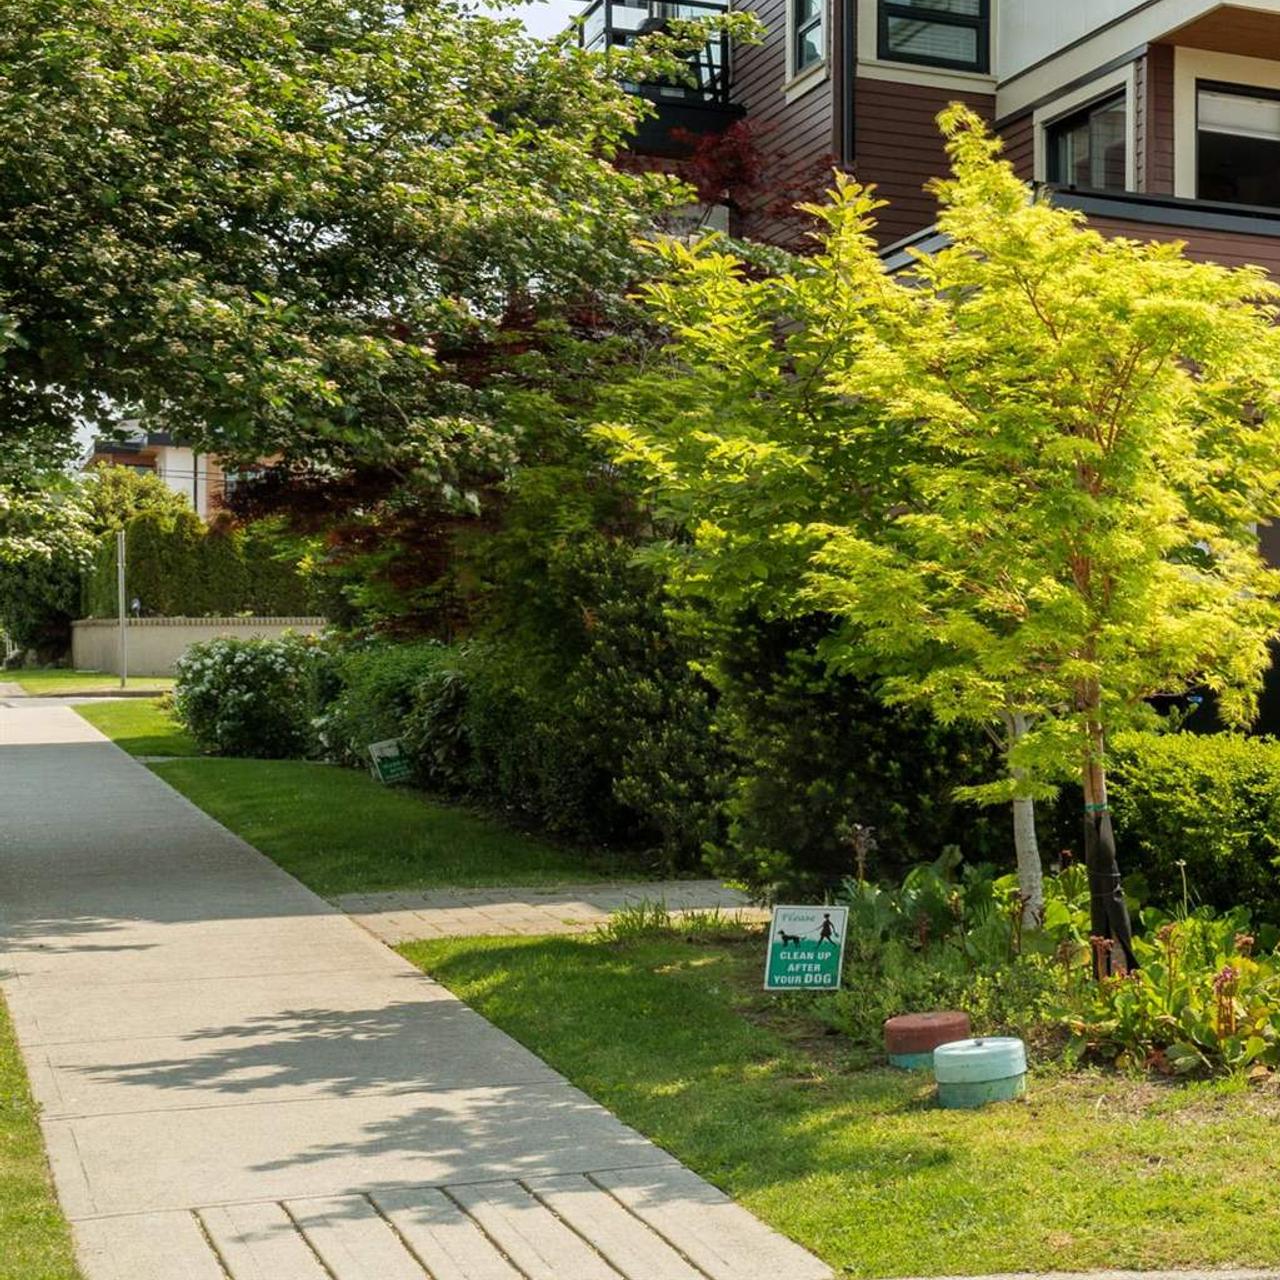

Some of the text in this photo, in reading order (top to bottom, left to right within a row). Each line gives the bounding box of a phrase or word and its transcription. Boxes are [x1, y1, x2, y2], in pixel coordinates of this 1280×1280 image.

[780, 951, 832, 960] CLEAN UP
[788, 963, 821, 972] AFTER
[774, 973, 832, 984] YOUR DOG
